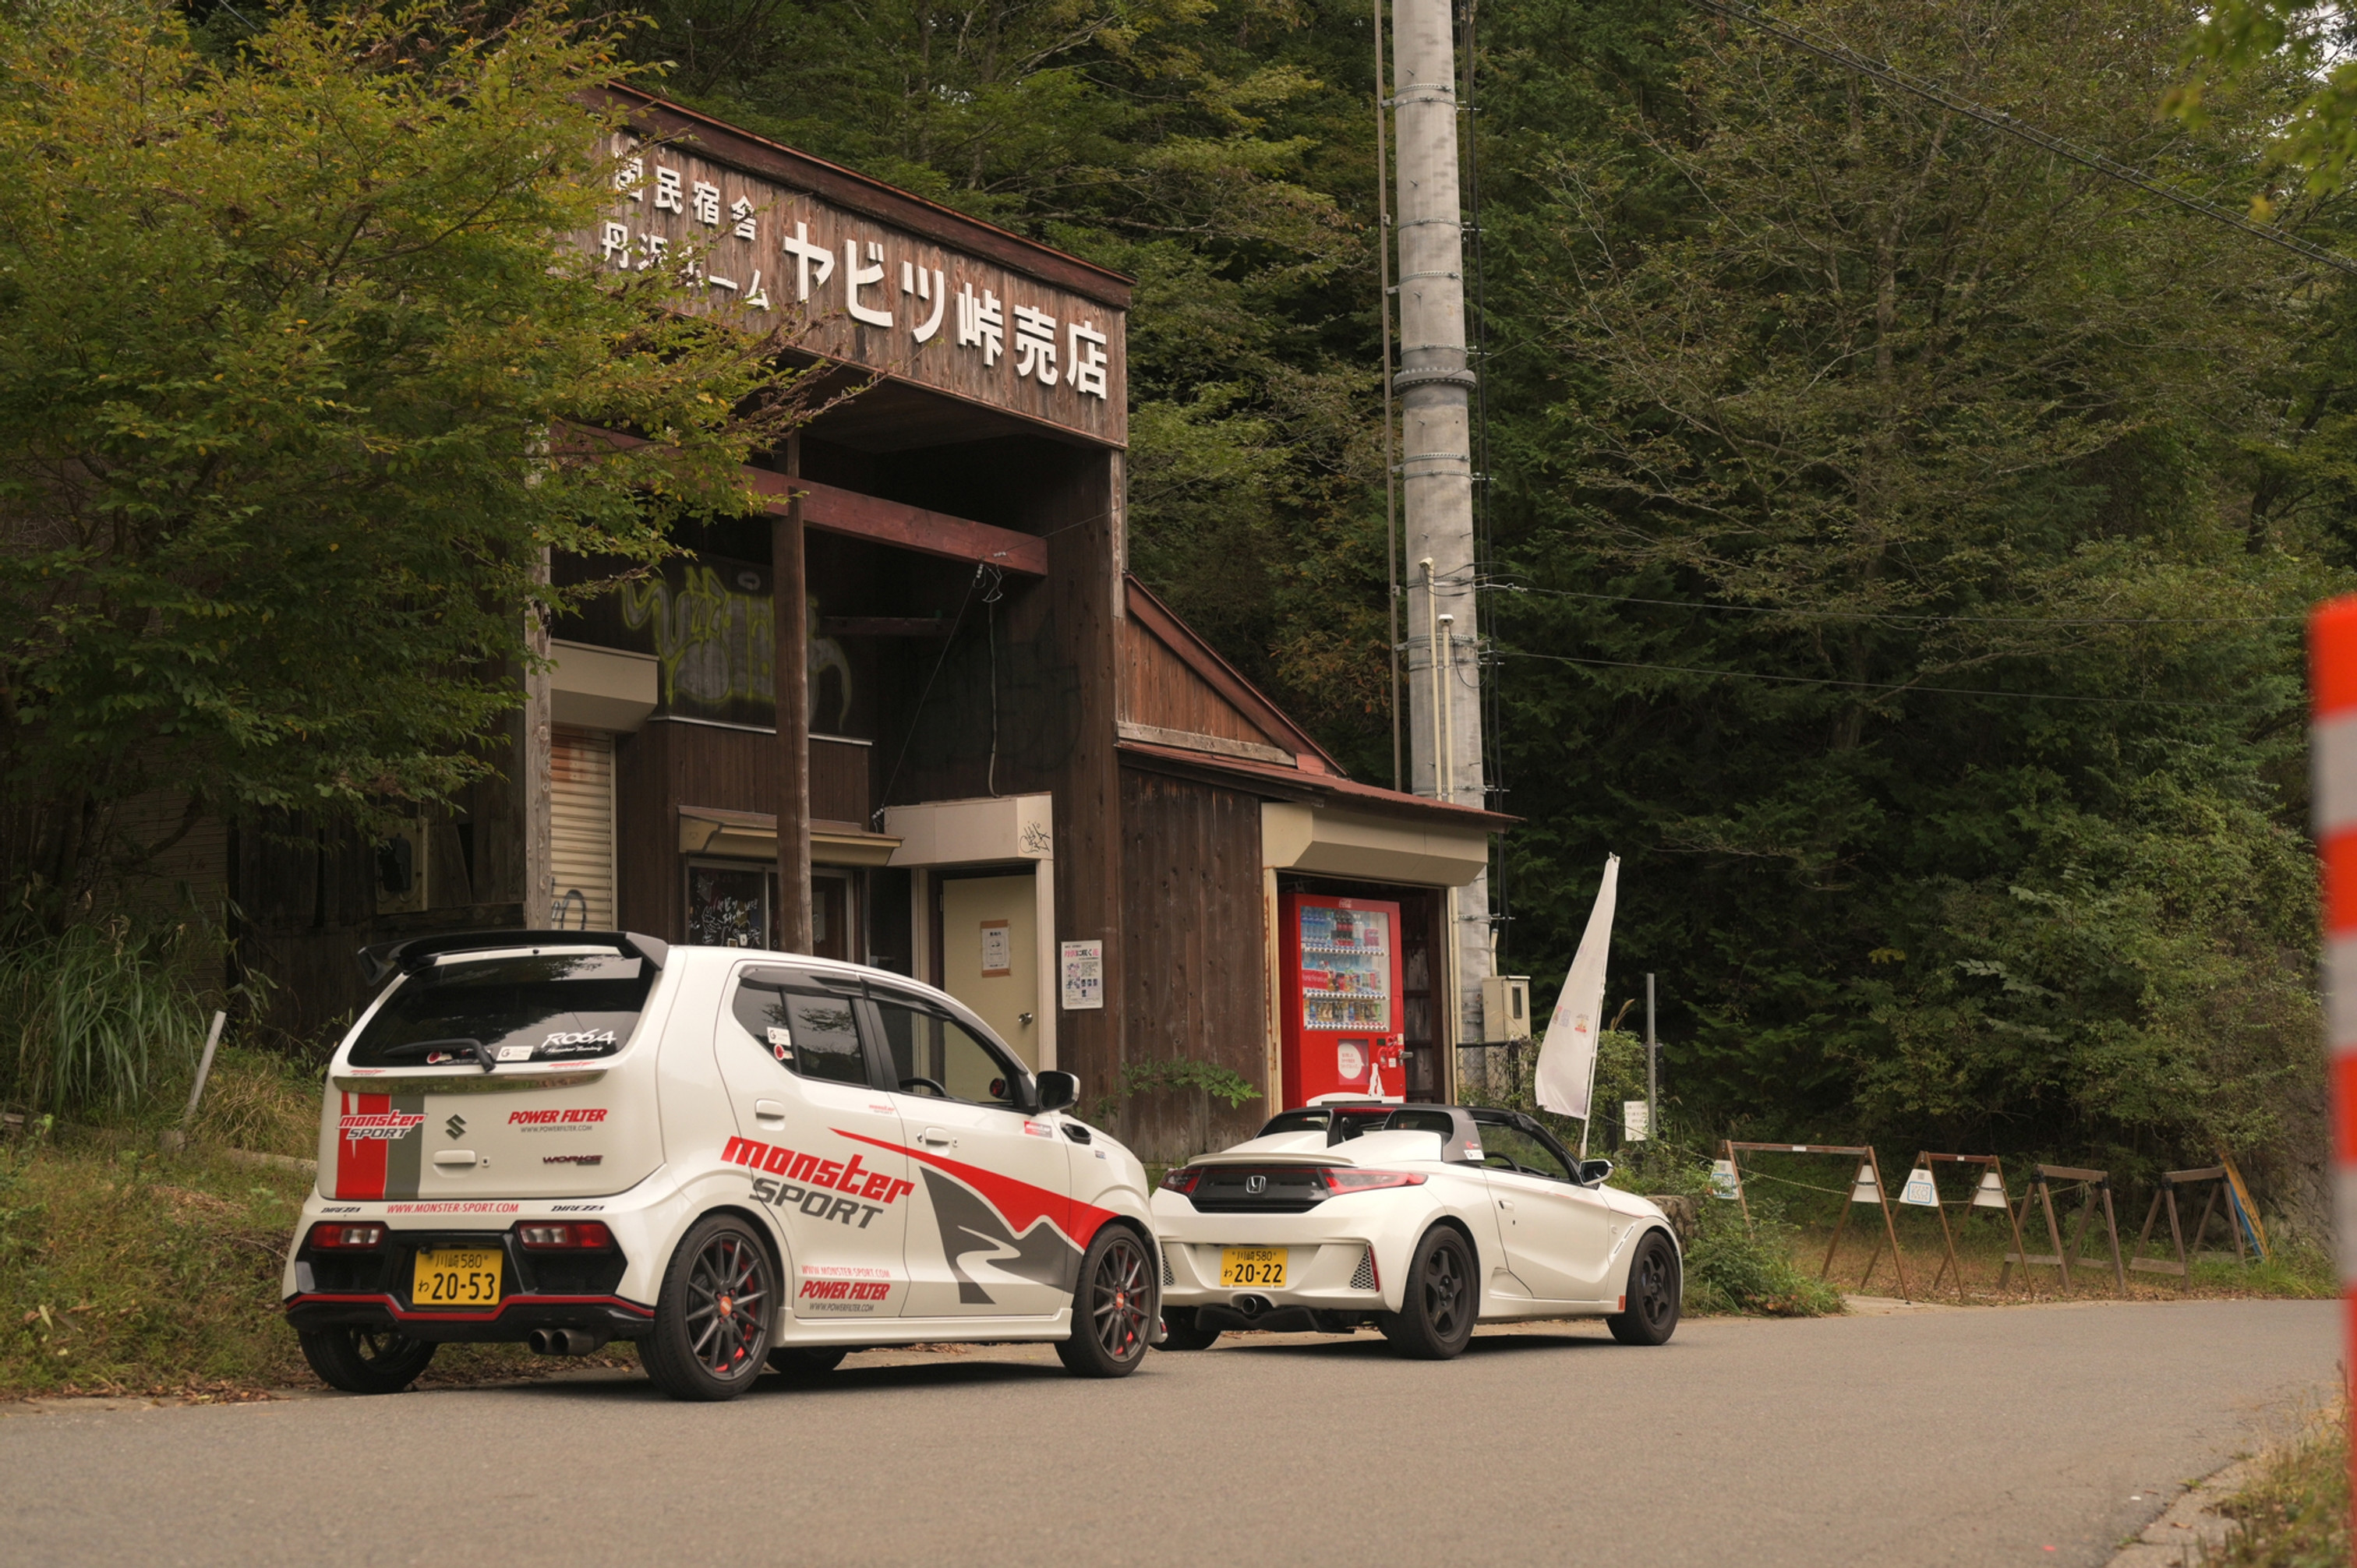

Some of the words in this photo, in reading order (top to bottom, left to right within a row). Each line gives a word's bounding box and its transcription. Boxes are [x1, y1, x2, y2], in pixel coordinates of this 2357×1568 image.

[614, 151, 757, 241] 国民宿舎
[783, 221, 1108, 400] ヤビツ峠売店
[338, 1111, 426, 1127] monster
[507, 1110, 560, 1125] POWER
[560, 1109, 608, 1123] FILTER
[348, 1128, 409, 1138] SPORT
[720, 1135, 915, 1204] monster
[387, 1203, 519, 1213] WWW.MONSTER-SPORT.COM
[748, 1178, 884, 1229] SPORT
[436, 1253, 458, 1268] 川崎
[461, 1253, 482, 1269] 580
[1256, 1252, 1273, 1261] 580
[801, 1265, 891, 1278] WWW.MONSTER-SPORT.COM
[1224, 1269, 1233, 1277] わ
[1234, 1263, 1283, 1283] 20-22
[419, 1280, 429, 1292] わ
[431, 1273, 495, 1300] 20-53
[799, 1280, 850, 1299] POWER
[848, 1282, 891, 1301] FILTER
[809, 1302, 874, 1312] WWW.POWERFILTER.COM
